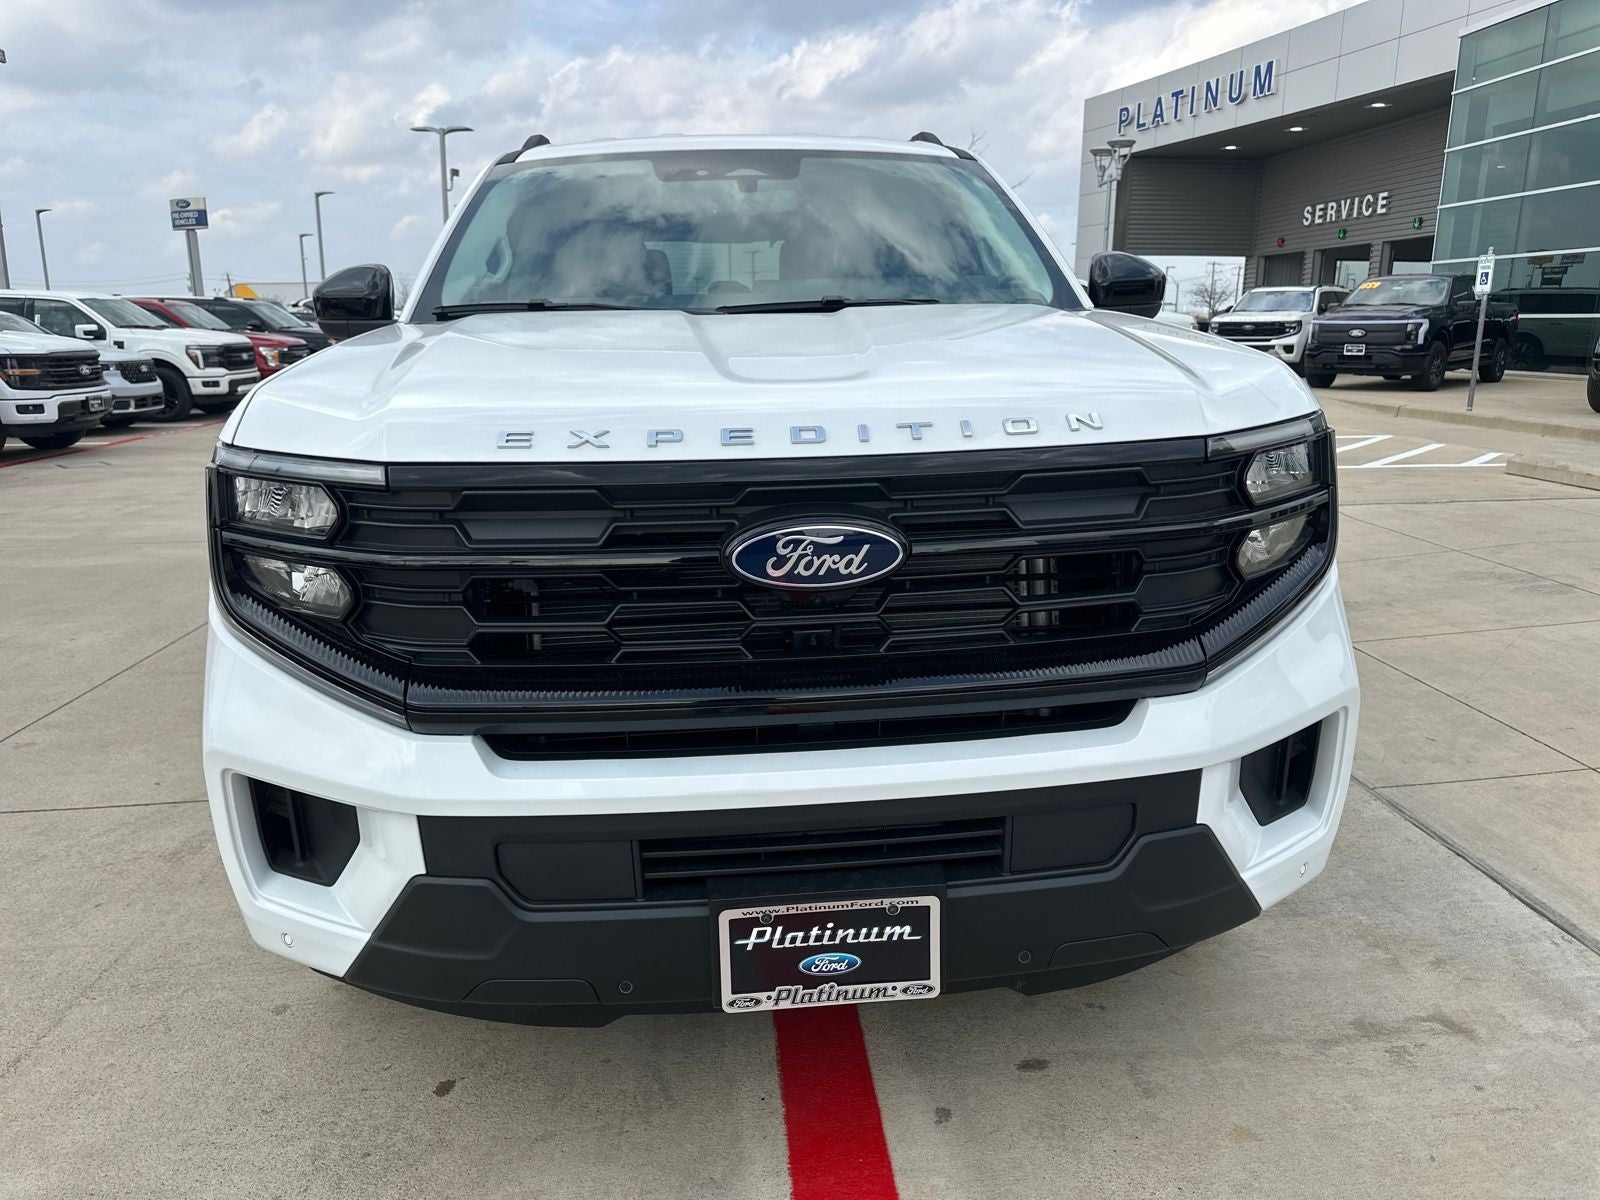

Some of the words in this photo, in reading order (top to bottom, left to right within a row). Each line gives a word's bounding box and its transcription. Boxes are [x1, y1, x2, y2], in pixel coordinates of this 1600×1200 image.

[1117, 59, 1276, 136] PLATINUM
[1302, 191, 1389, 226] SERVICE
[497, 412, 1103, 449] EXPEDITION
[766, 535, 871, 577] Ford
[741, 898, 919, 917] www.PlatinumFord.com
[733, 922, 922, 951] Platinum
[811, 956, 848, 972] Ford
[773, 984, 897, 1006] Platinum
